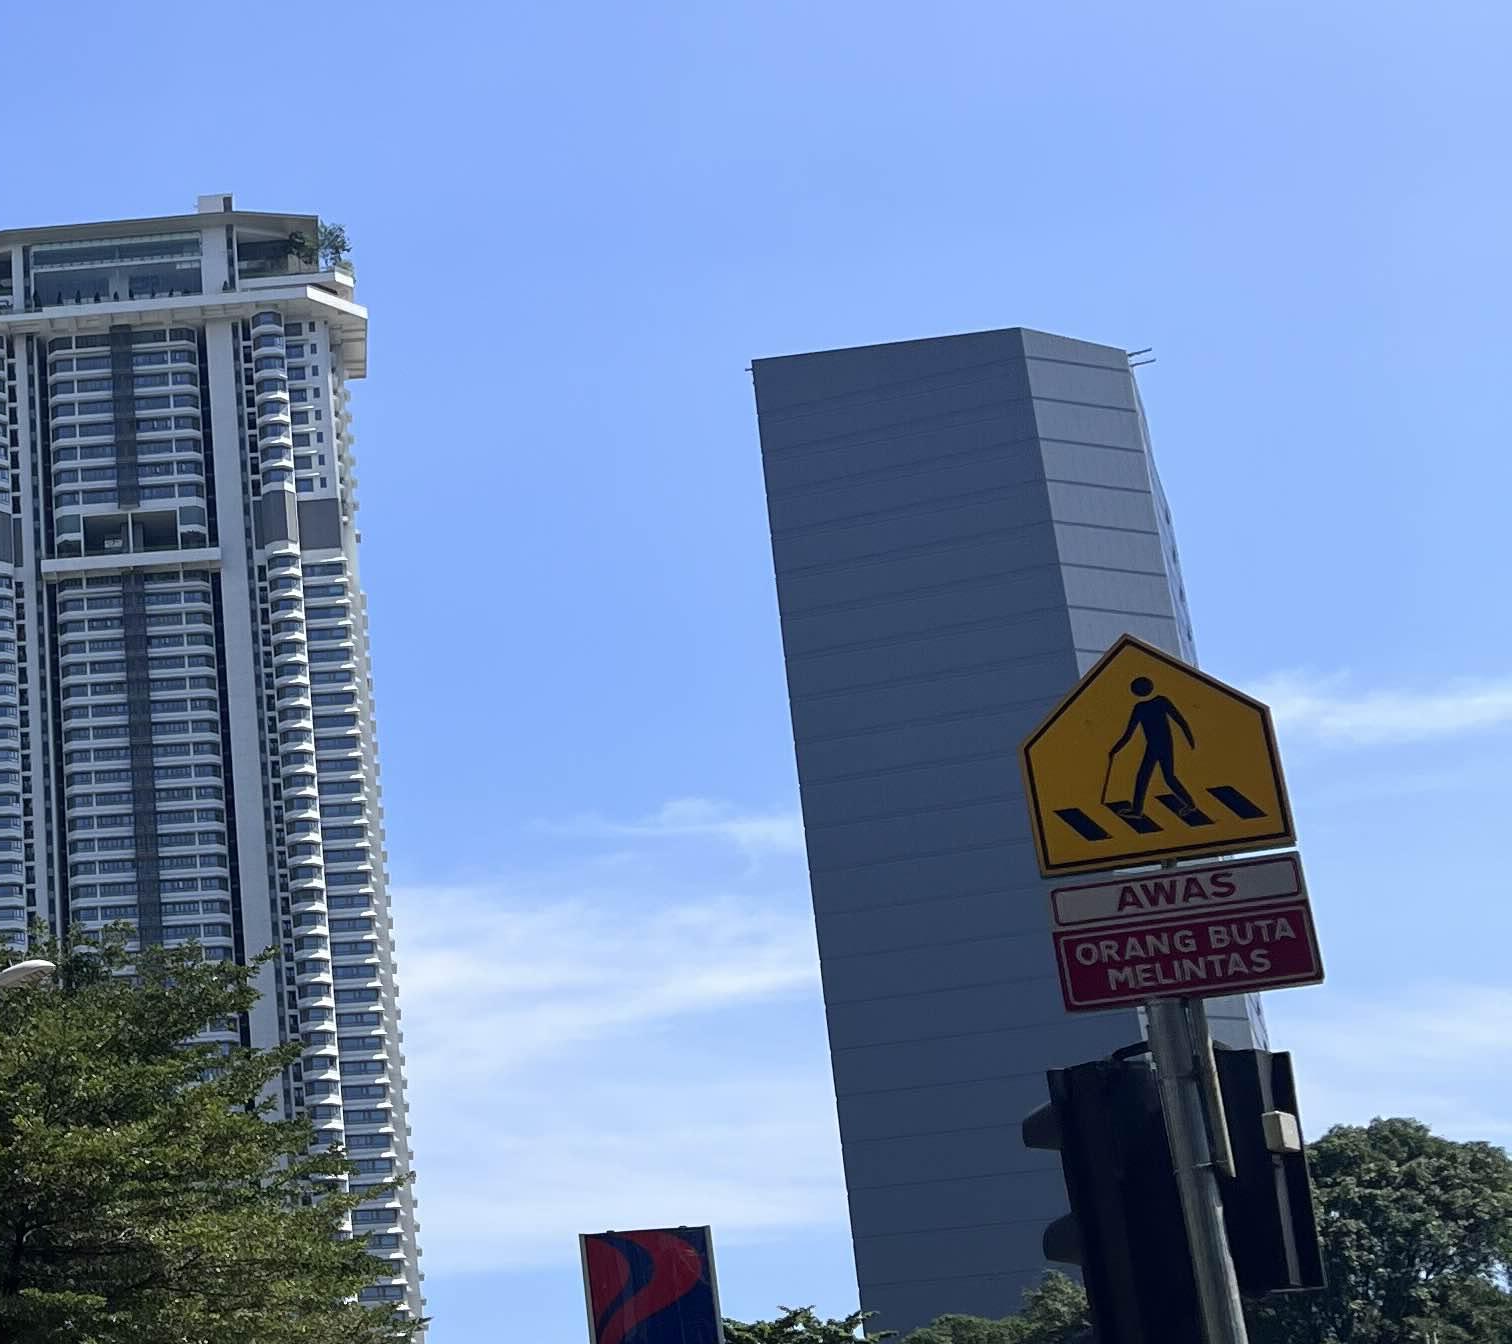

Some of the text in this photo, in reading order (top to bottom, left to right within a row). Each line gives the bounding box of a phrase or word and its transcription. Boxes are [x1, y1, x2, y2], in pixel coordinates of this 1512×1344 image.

[1117, 872, 1236, 912] AWAS
[1075, 917, 1297, 966] ORANG BUTA
[1107, 949, 1272, 991] MELINTAS
